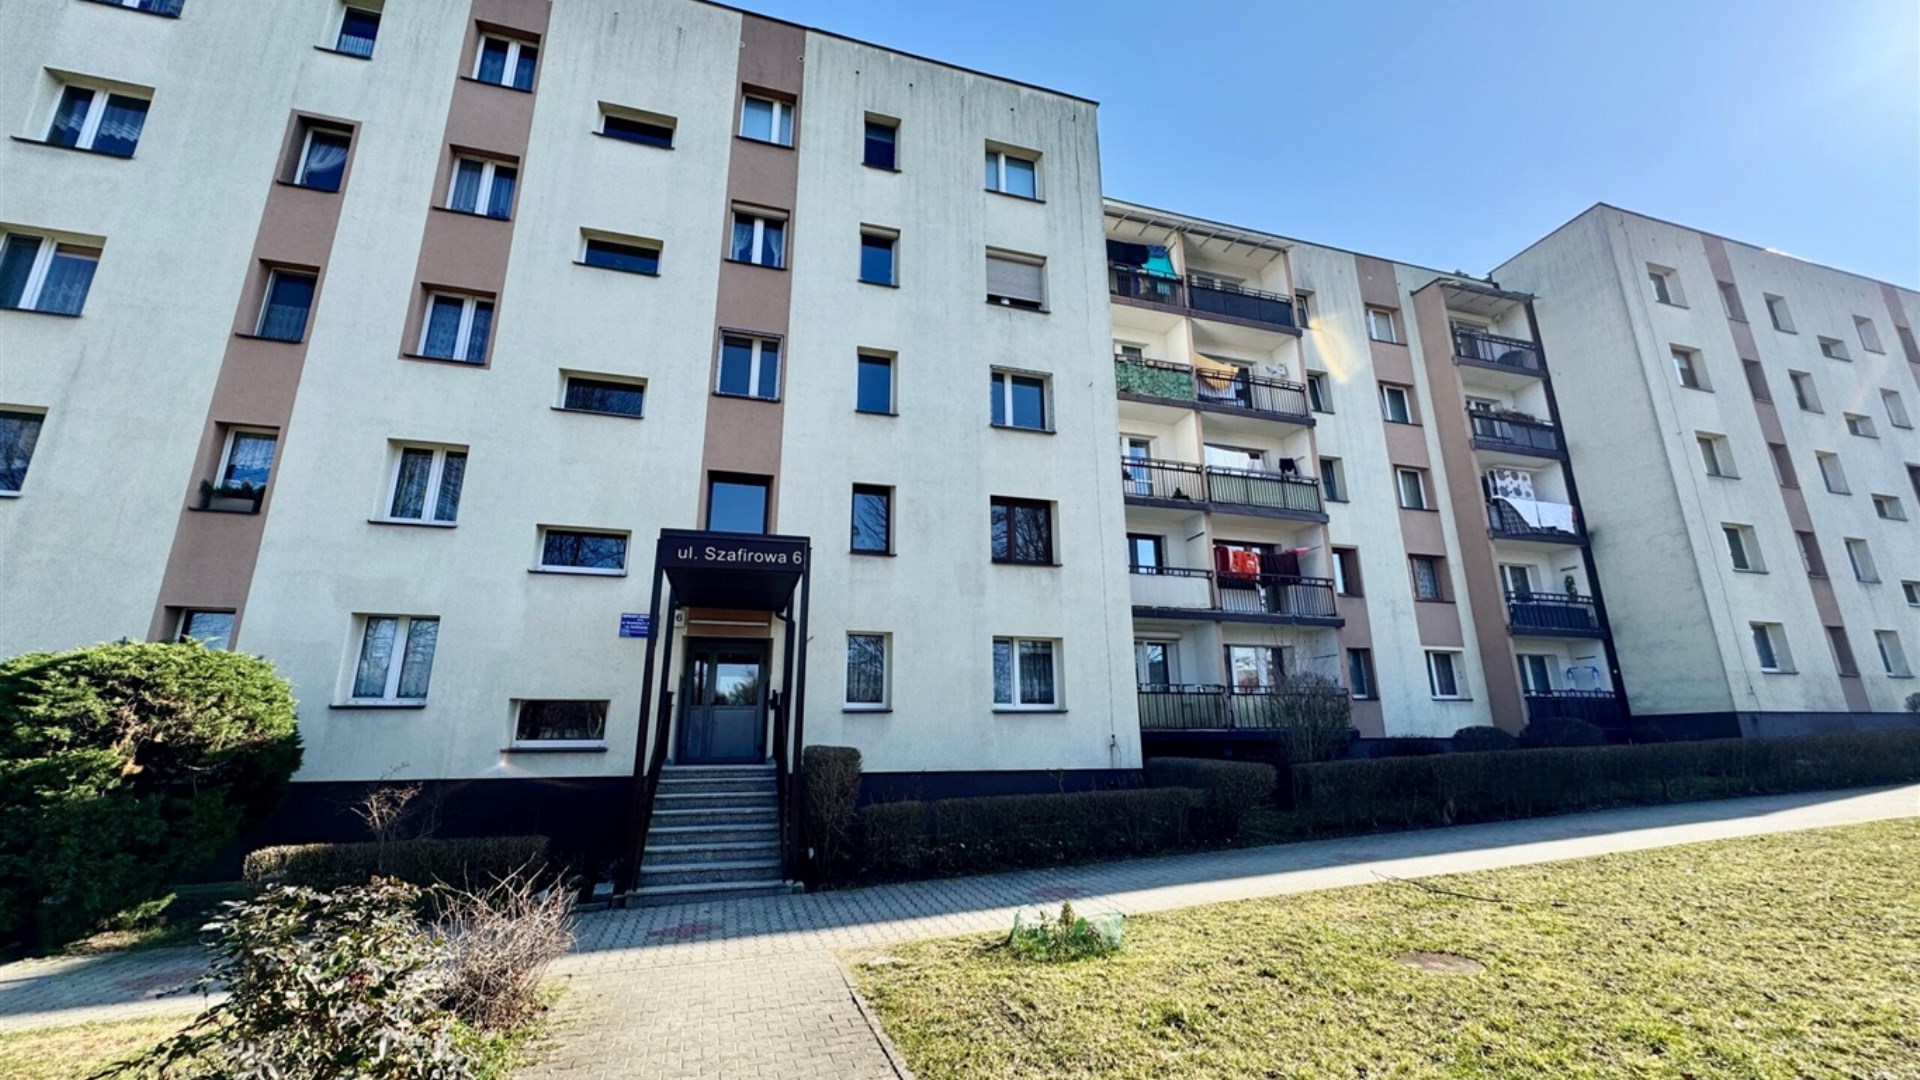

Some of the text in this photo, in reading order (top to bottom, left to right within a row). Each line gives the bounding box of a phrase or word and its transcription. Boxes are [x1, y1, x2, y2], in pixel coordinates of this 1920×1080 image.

[677, 546, 802, 564] ul. Szafirowa 6
[675, 613, 683, 622] 6
